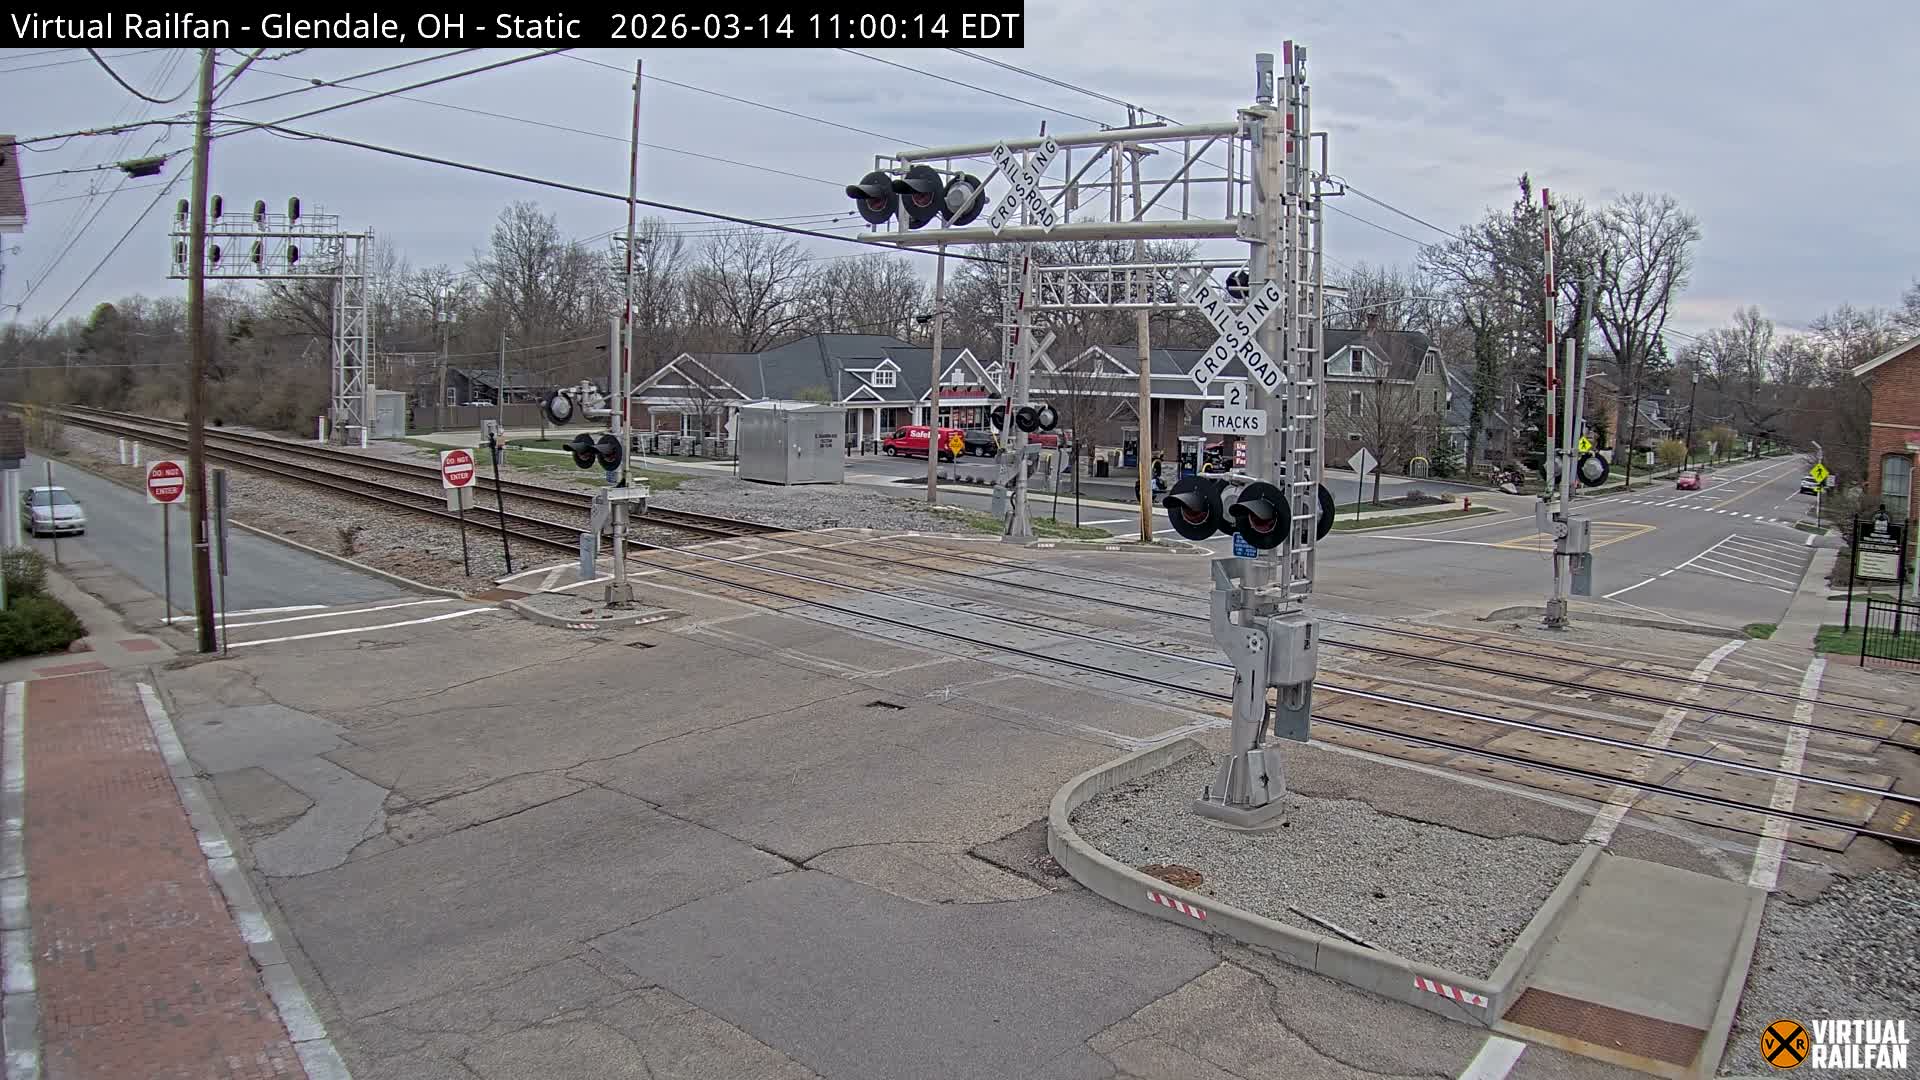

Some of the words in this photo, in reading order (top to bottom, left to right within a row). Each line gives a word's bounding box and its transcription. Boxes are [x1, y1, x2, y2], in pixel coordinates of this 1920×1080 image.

[991, 141, 1056, 229] CROSSING
[993, 145, 1054, 227] RAILROAD
[1194, 287, 1280, 384] CROSSING
[1195, 286, 1278, 387] RAILROAD
[1211, 415, 1259, 430] TRACKS
[1230, 388, 1240, 405] 2
[152, 469, 162, 477] DO
[165, 468, 179, 476] NOT
